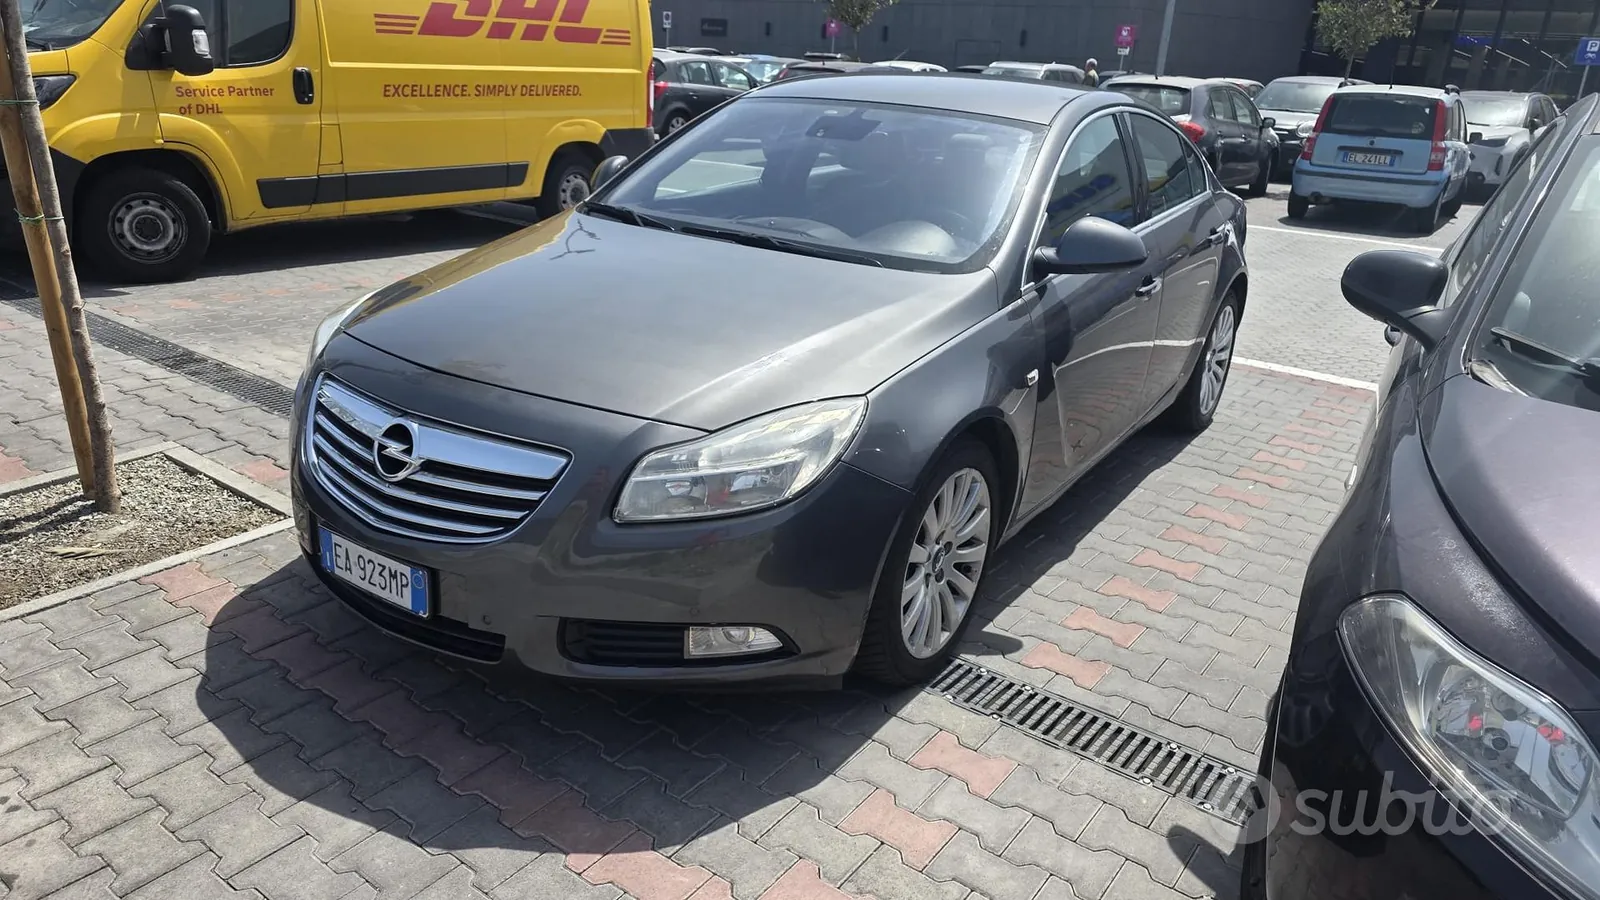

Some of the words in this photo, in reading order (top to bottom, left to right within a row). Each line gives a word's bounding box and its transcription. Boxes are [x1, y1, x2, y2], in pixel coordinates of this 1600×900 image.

[417, 0, 604, 44] DHL
[175, 85, 225, 98] Service
[227, 85, 275, 97] Partner
[383, 84, 471, 98] EXCELLENCE.
[474, 84, 518, 97] SIMPLY
[520, 84, 582, 97] DELIVERED.
[179, 103, 192, 115] of
[196, 103, 223, 115] DHL
[333, 541, 353, 575] EA
[357, 554, 409, 599] 923MP
